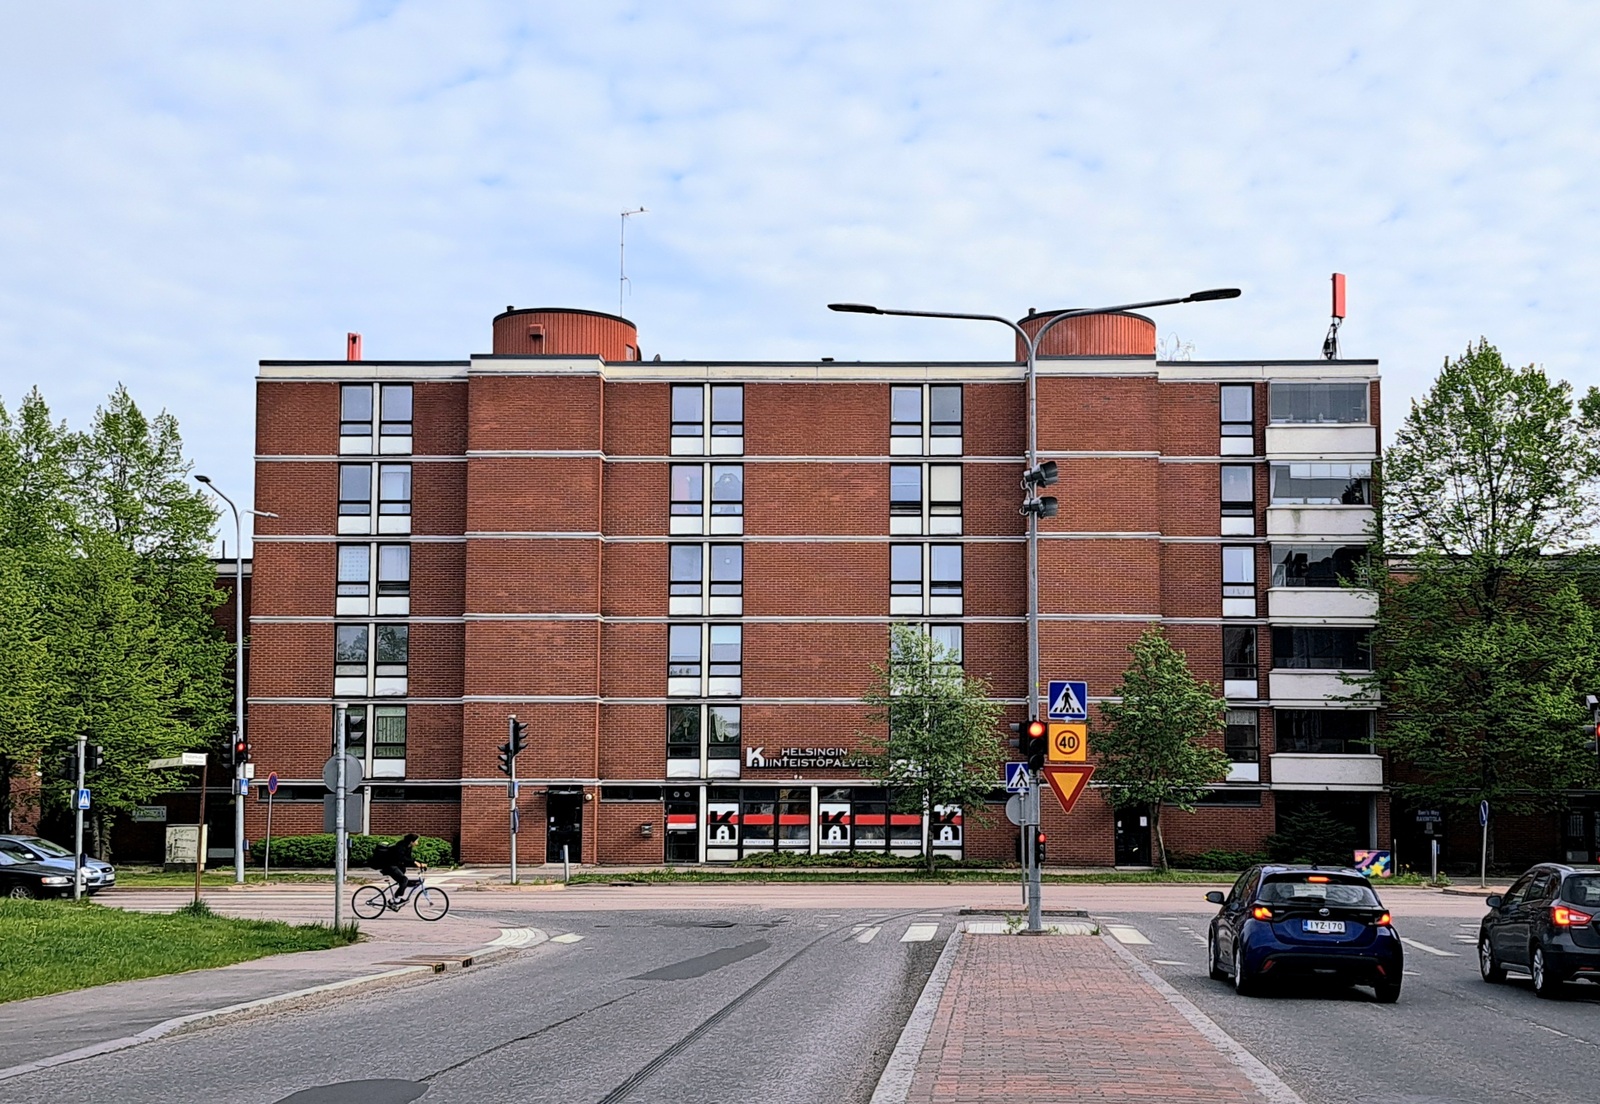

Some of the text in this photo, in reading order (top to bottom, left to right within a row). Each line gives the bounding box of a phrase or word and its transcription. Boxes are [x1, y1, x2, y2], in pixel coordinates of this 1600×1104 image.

[1059, 736, 1075, 749] 40
[781, 747, 848, 756] HELSINGIN
[1310, 921, 1343, 930] IYZ-170
